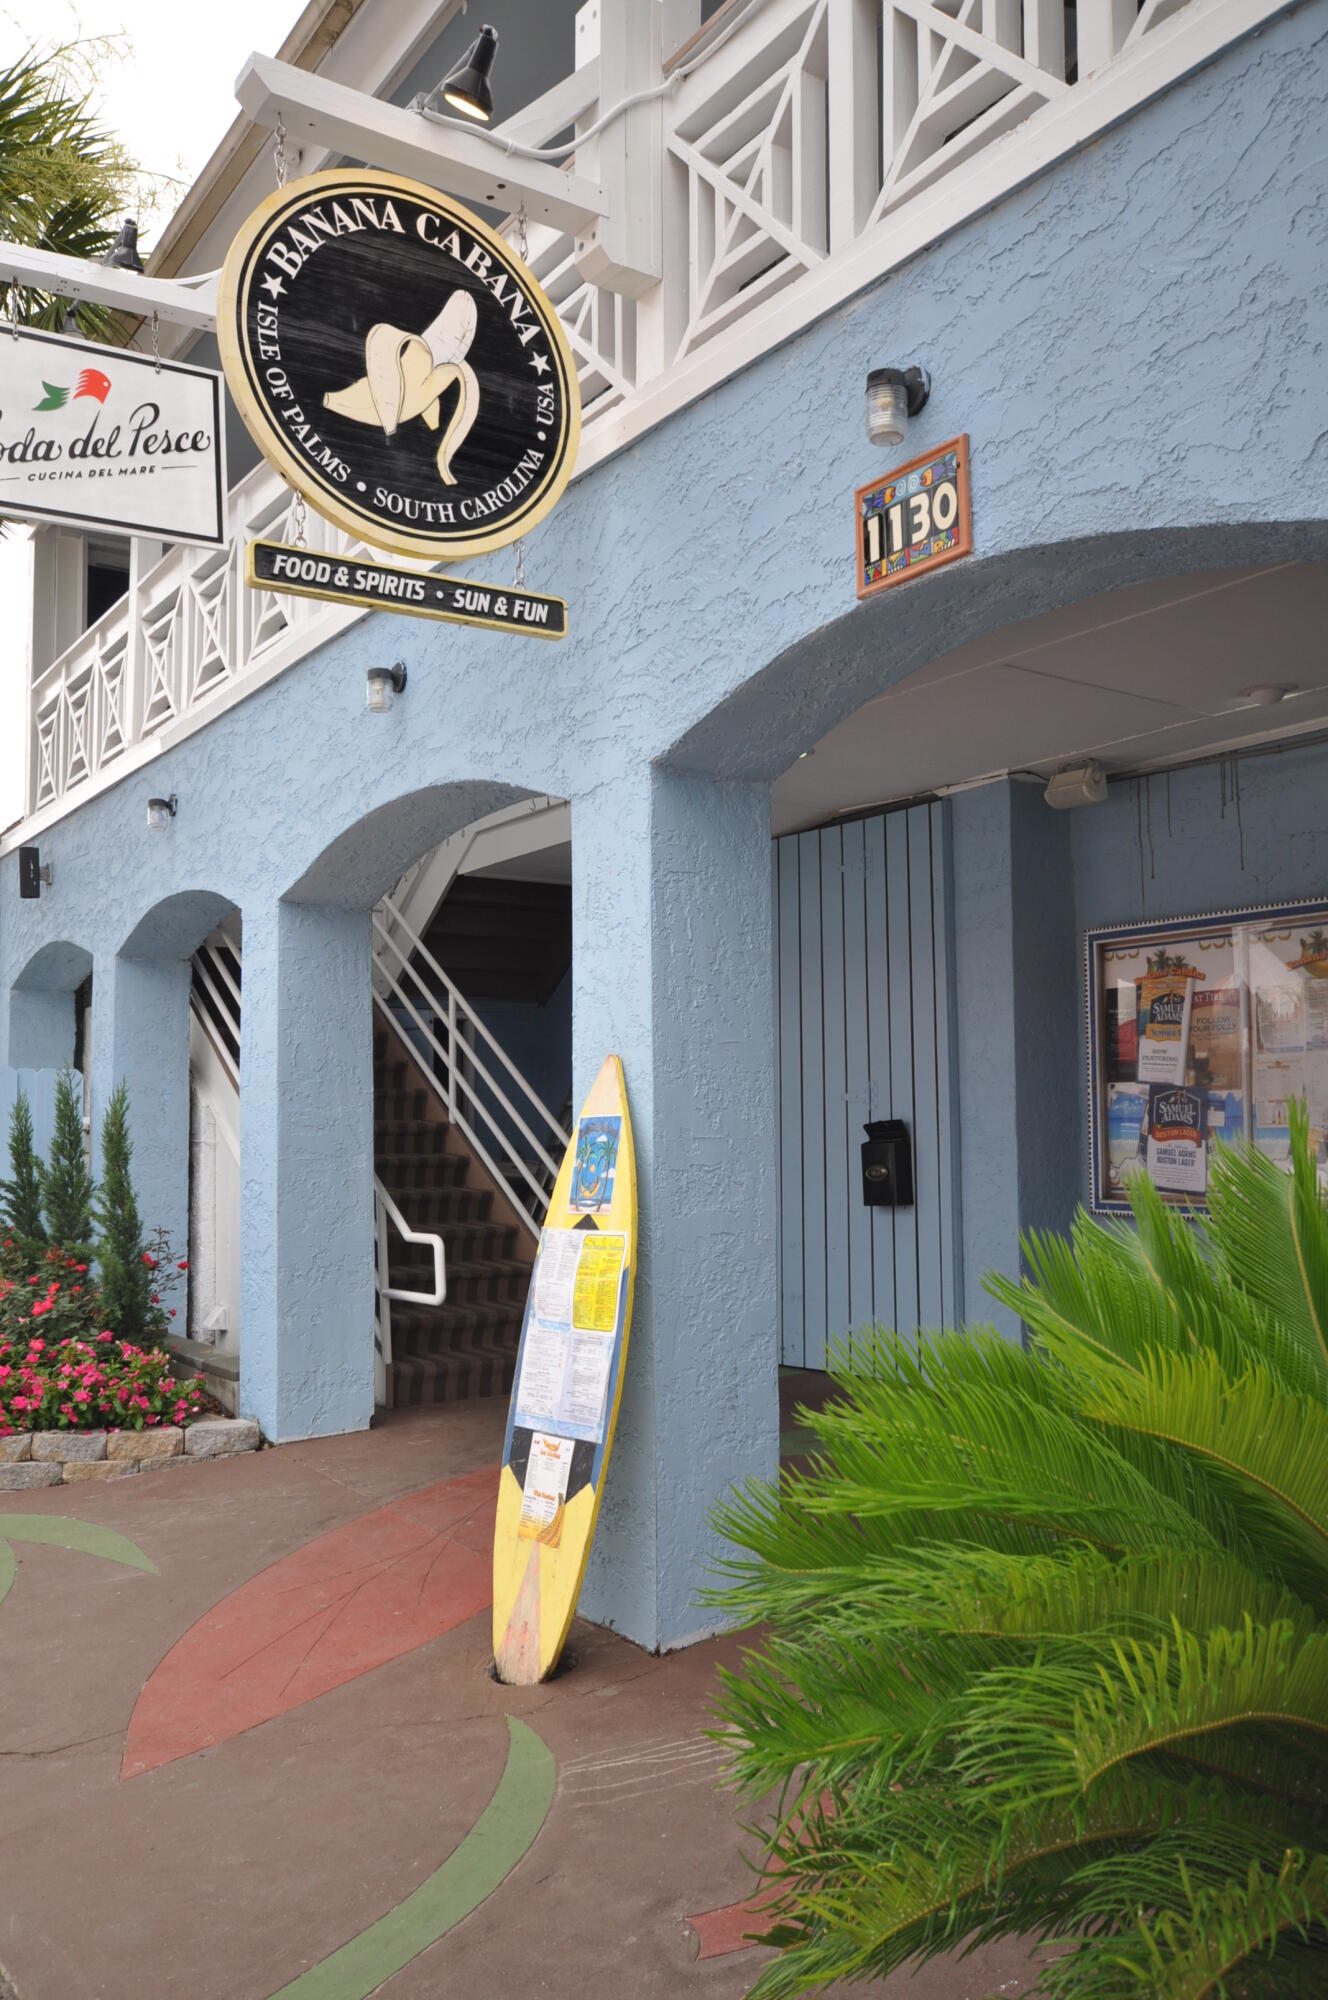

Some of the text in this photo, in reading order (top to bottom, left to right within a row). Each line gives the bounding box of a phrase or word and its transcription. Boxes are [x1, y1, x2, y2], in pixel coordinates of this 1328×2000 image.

[265, 198, 541, 347] BANANA CABANA
[69, 409, 122, 459] del
[128, 402, 211, 456] Pesce
[256, 300, 554, 523] ISLE OF PALMS SOUTH CAROLINA USA
[27, 465, 156, 482] CUCINA DEL MARE
[867, 481, 958, 564] 1130
[272, 554, 549, 624] FOOD & SPIRITS SUN & FUN
[1153, 1002, 1184, 1014] SAMUE
[1159, 1101, 1194, 1114] SAMUEL
[1161, 1112, 1193, 1125] ADAMS
